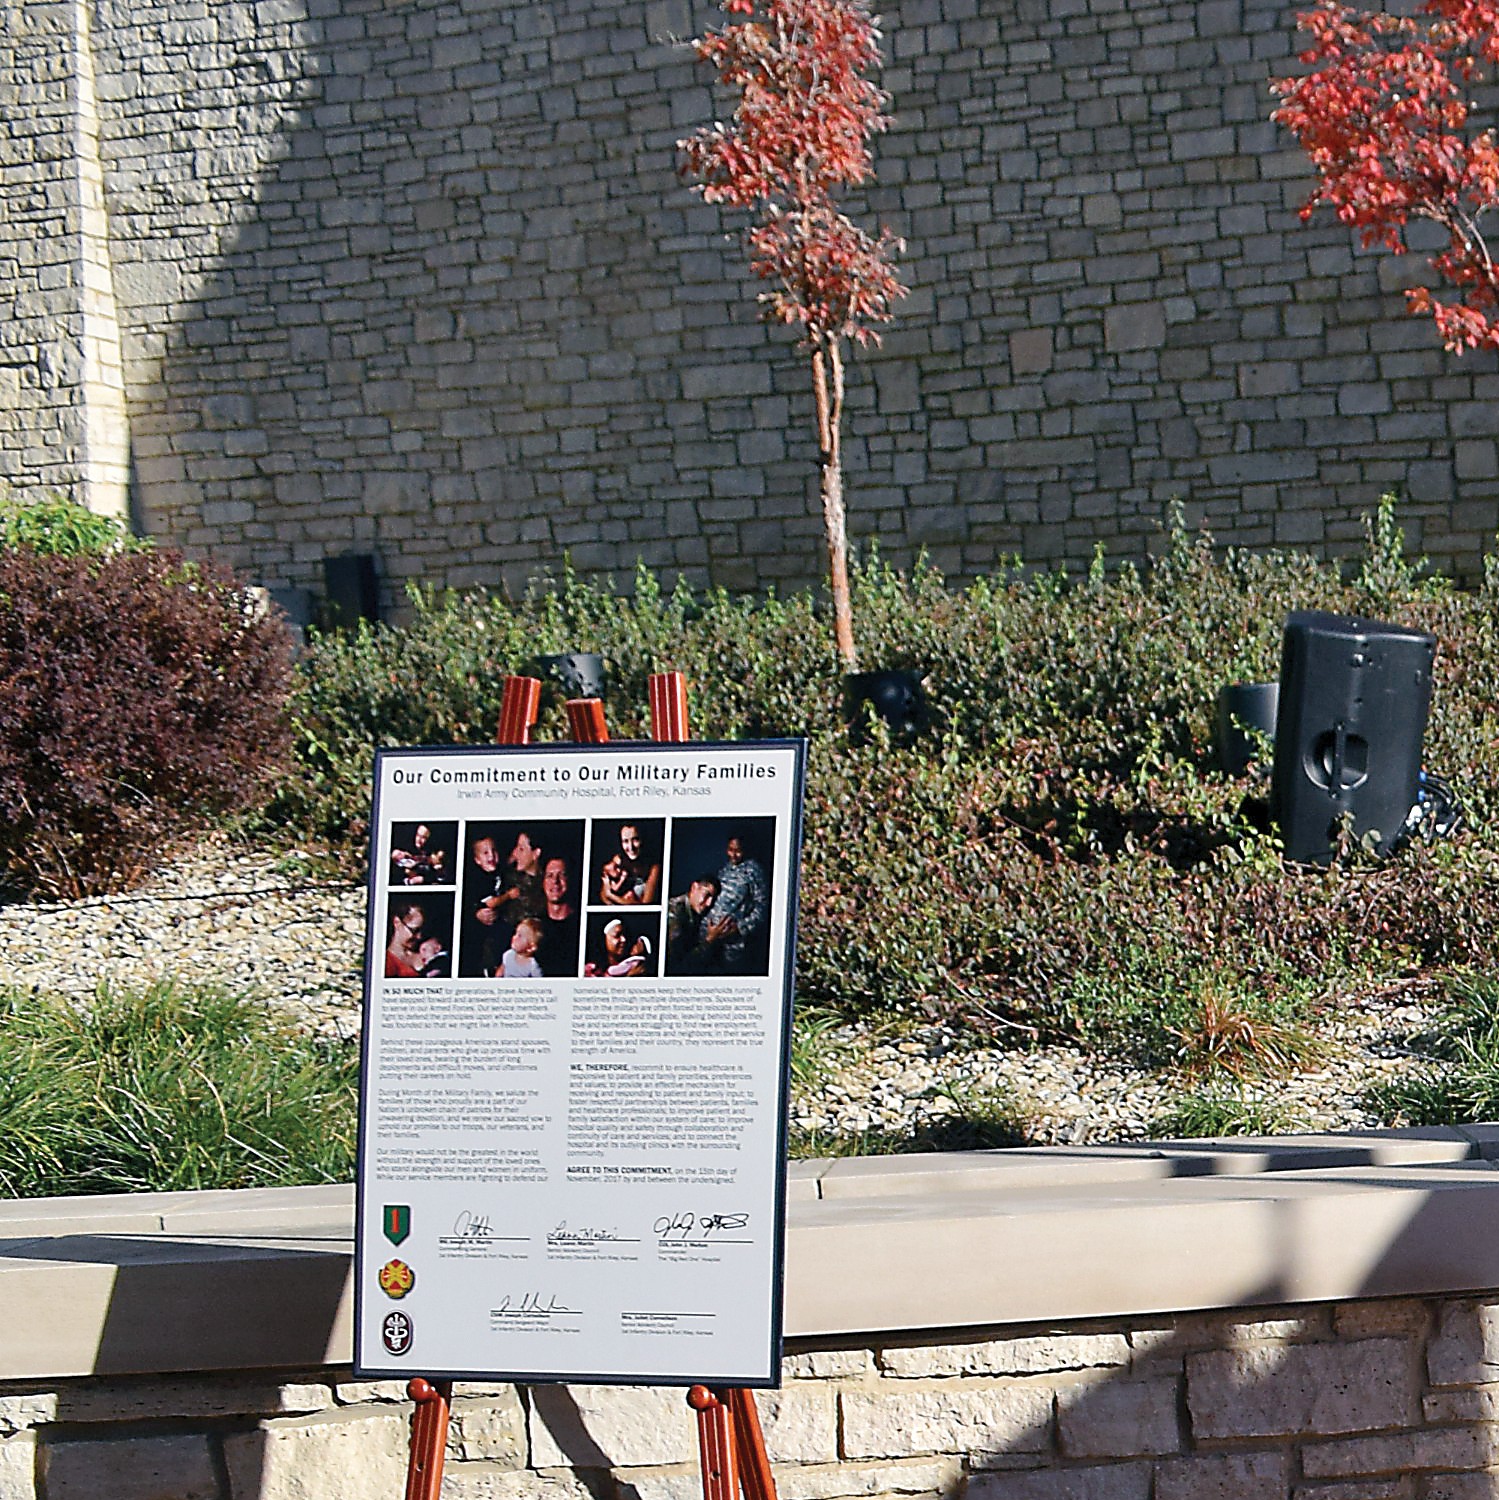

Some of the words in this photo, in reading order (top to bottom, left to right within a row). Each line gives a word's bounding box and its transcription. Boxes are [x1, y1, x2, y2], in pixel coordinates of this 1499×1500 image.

[391, 767, 424, 785] Our
[428, 765, 547, 785] Commitment
[551, 766, 572, 783] to
[576, 764, 610, 782] Our
[615, 762, 690, 784] Military
[695, 761, 777, 780] Families
[456, 788, 482, 799] Irwin
[483, 787, 509, 801] Army
[510, 786, 568, 800] Community
[570, 785, 617, 798] Hospital,
[618, 784, 640, 797] Fort
[641, 784, 670, 798] Riley,
[671, 784, 712, 796] Kansas
[391, 987, 401, 995] SO
[402, 987, 424, 995] MUCH
[425, 986, 443, 994] THAT
[569, 1063, 583, 1071] WE,
[584, 1062, 628, 1071] THEREFORE,
[566, 1165, 590, 1174] AGREE
[591, 1165, 601, 1174] TO
[602, 1165, 619, 1174] THIS
[620, 1165, 672, 1174] COMMITMENT,
